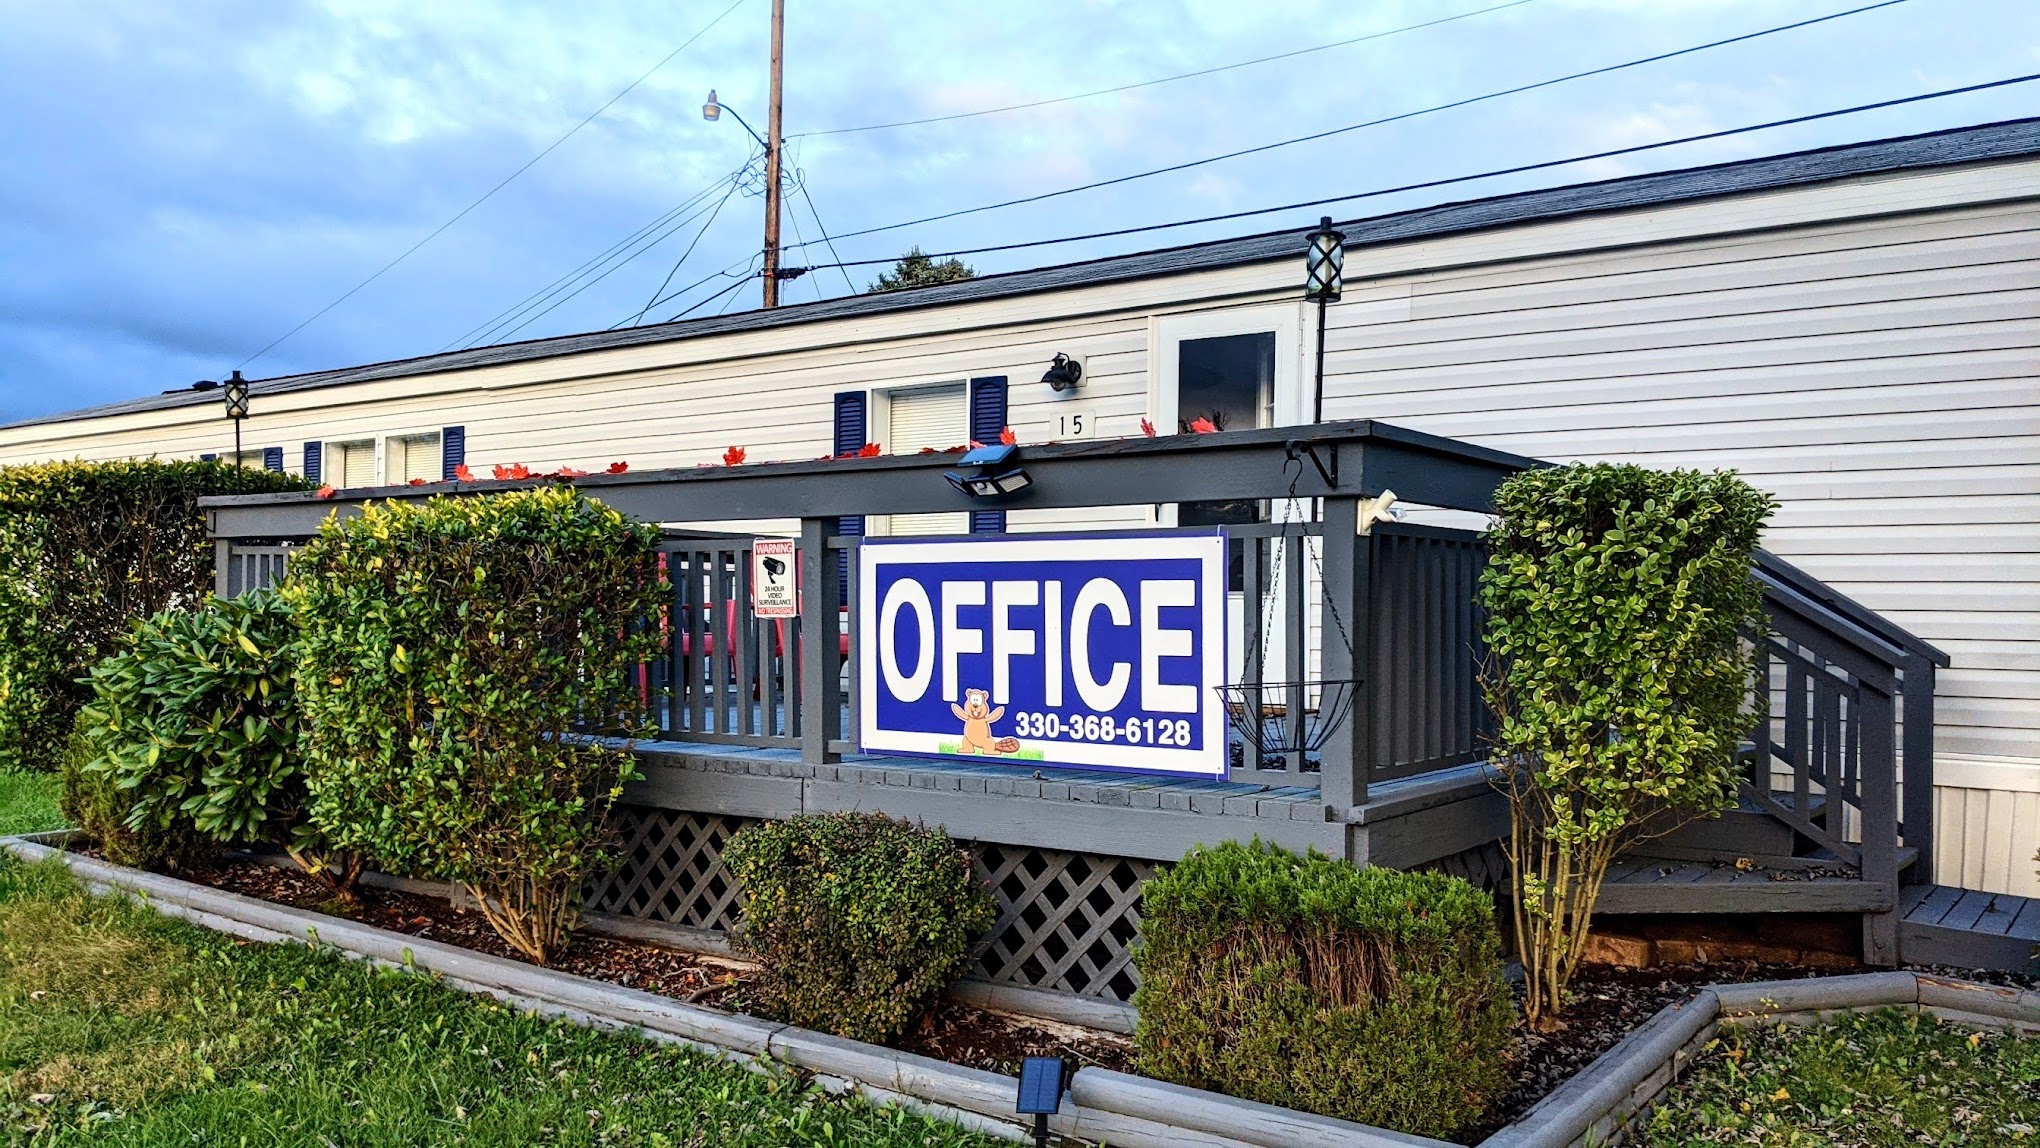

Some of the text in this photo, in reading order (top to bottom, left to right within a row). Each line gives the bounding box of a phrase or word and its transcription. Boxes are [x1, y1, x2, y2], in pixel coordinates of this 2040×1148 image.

[1060, 415, 1082, 435] 15
[757, 543, 792, 554] WARNING
[880, 577, 1197, 712] OFFICE
[1015, 711, 1191, 746] 330-368-6128
